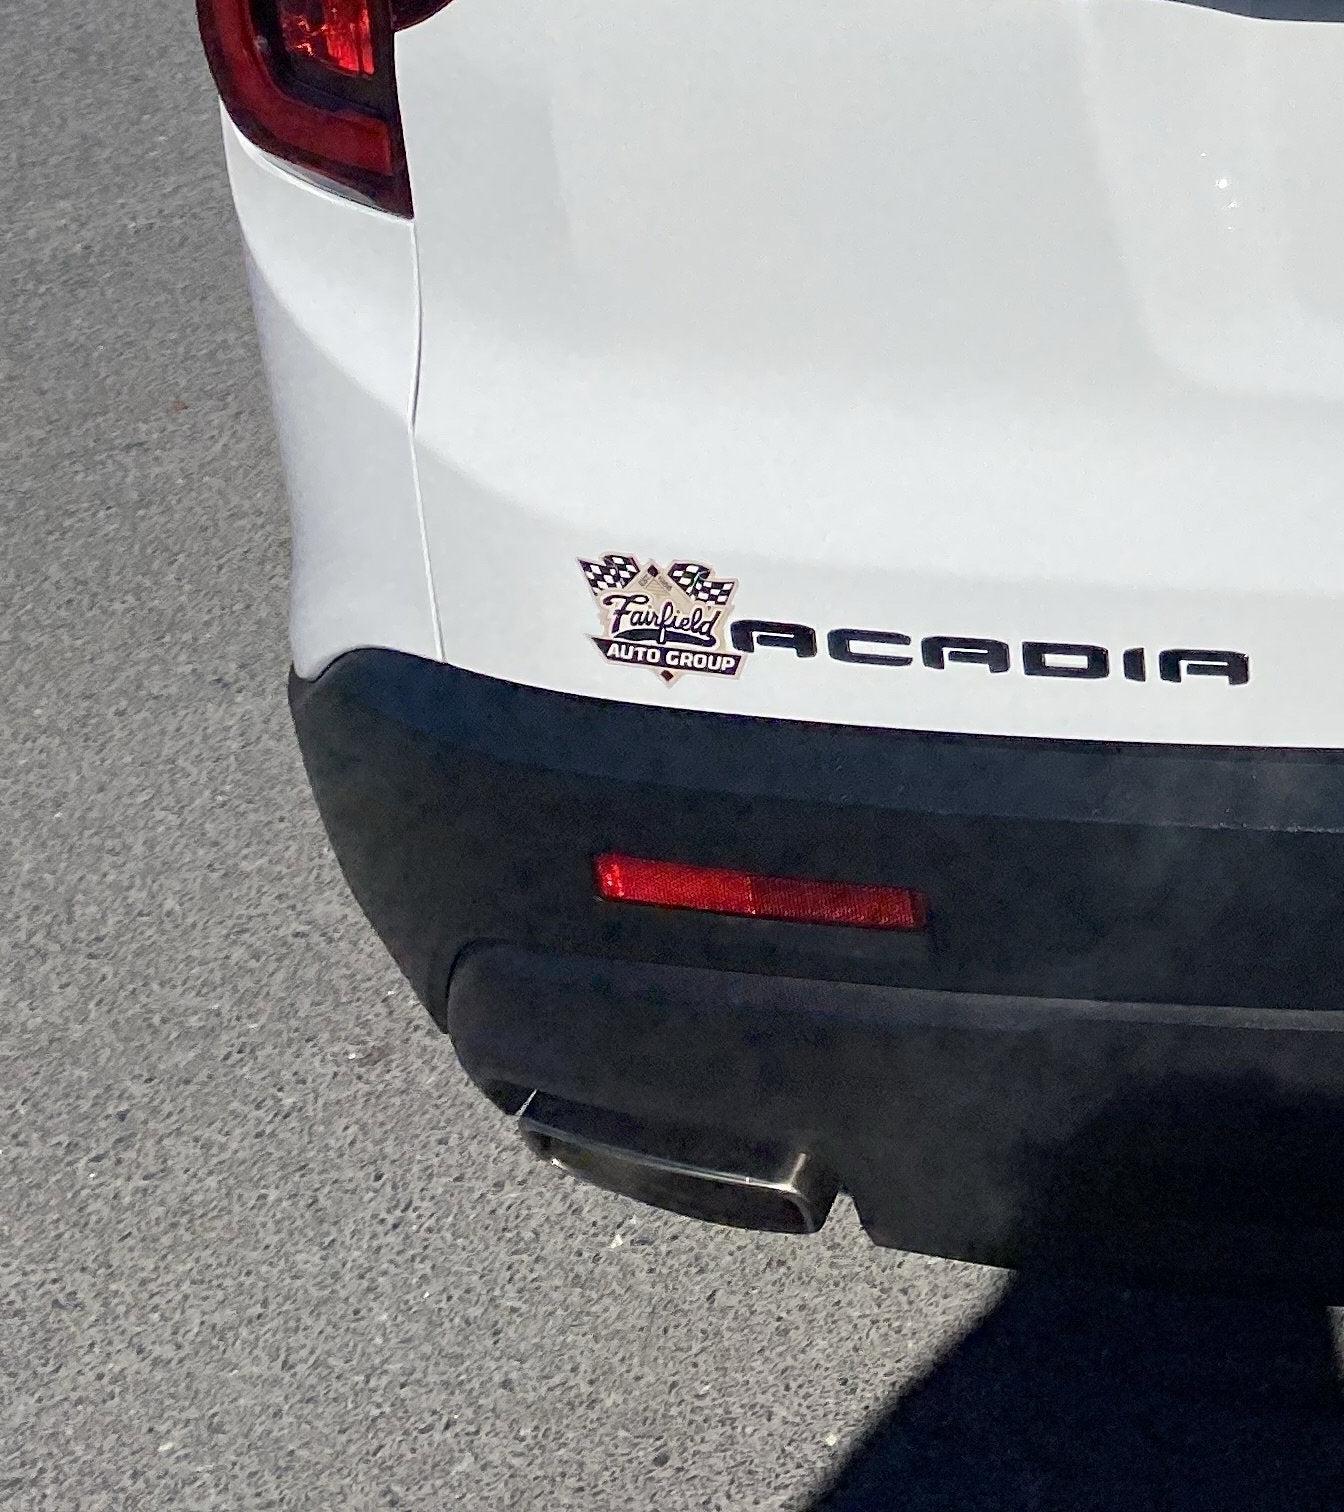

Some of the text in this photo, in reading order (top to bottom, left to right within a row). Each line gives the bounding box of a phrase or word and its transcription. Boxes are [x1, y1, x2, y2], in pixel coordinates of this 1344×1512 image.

[602, 594, 722, 643] Fairfield
[606, 643, 736, 672] AUTO GROUP
[730, 619, 1250, 686] ACADIA
